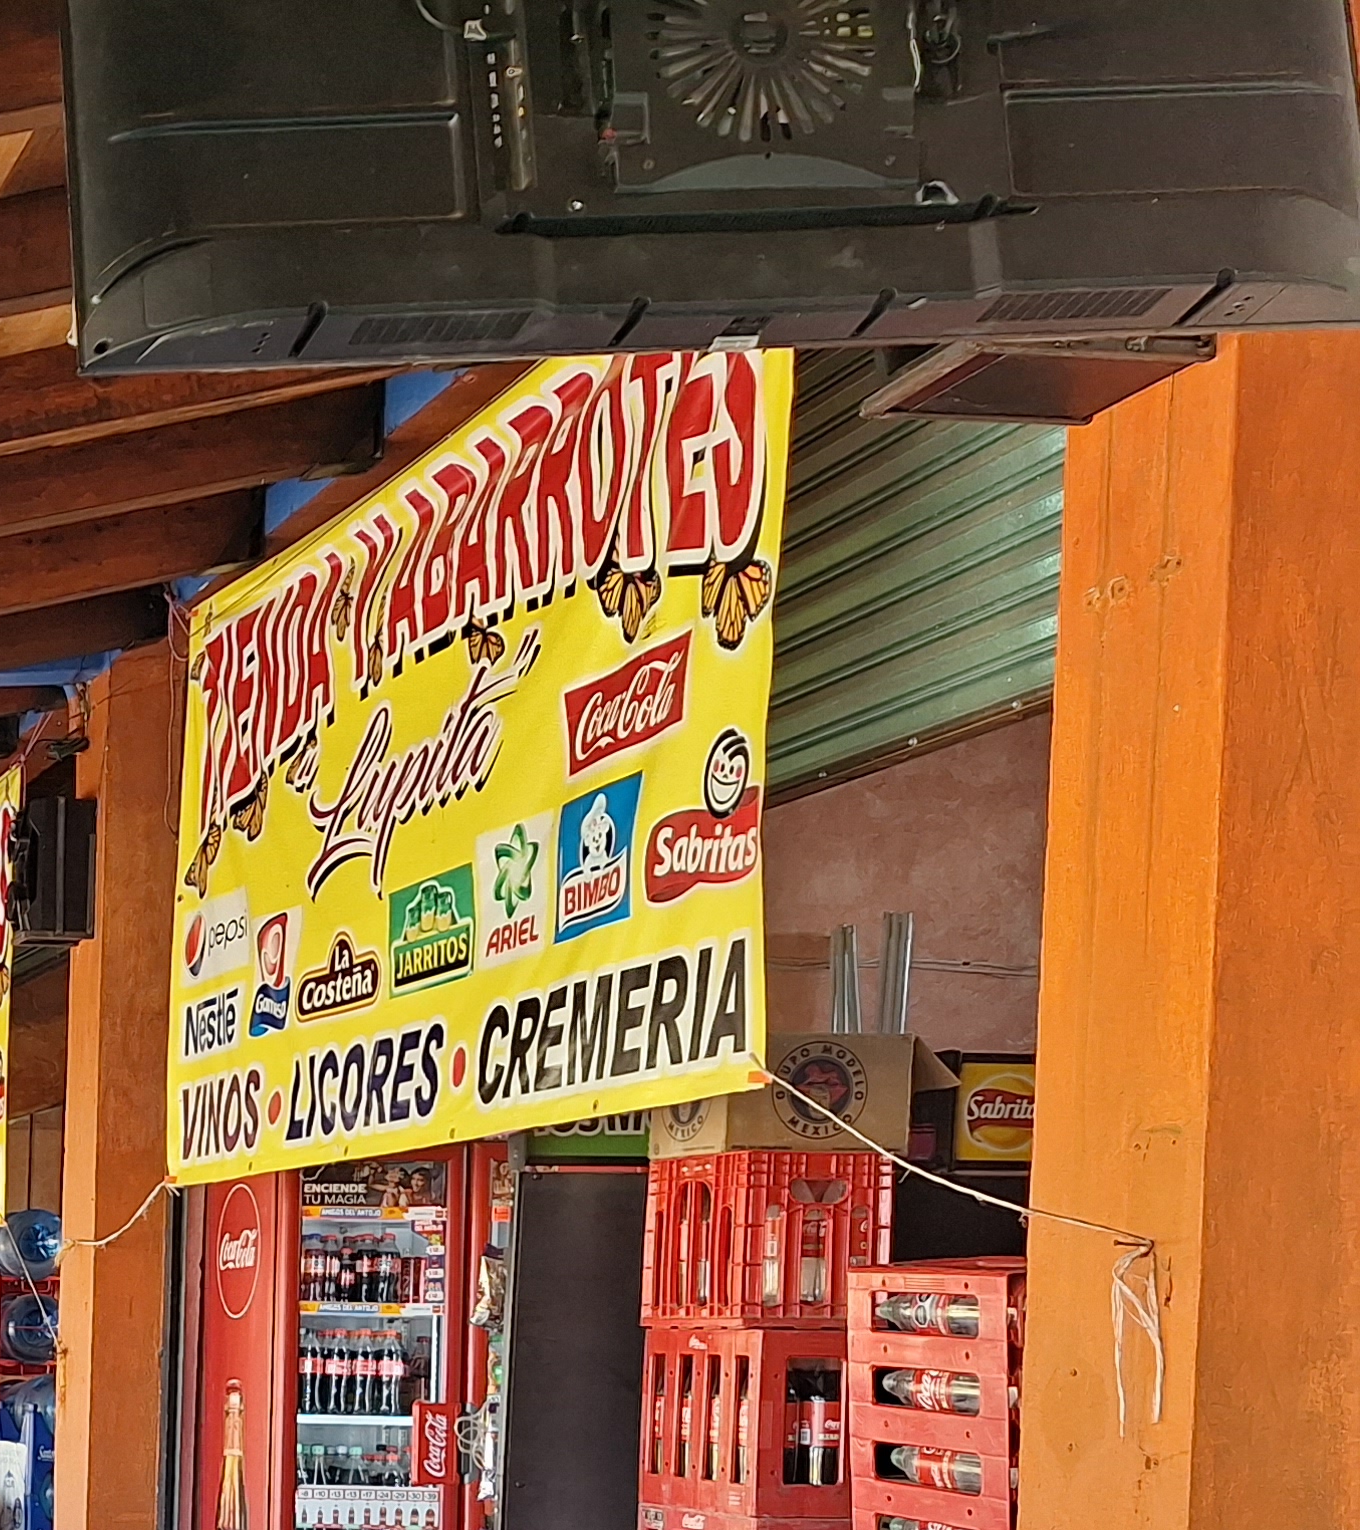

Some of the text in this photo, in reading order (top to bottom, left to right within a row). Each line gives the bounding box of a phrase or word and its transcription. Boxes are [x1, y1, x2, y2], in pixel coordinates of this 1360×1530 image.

[200, 351, 763, 834] TIENDA Y ABARROTES
[575, 650, 684, 761] Coca-Cola
[653, 822, 759, 878] Sabritas
[564, 864, 622, 917] BIMBO
[208, 909, 248, 956] pepsi
[396, 933, 468, 979] JARRITOS
[486, 915, 539, 958] ARIEL
[334, 946, 350, 972] La
[302, 967, 374, 1011] Costeña
[184, 987, 240, 1058] Nestlé
[181, 938, 748, 1161] VINOS LICORES CREMERIA
[822, 1044, 865, 1102] MODELO
[786, 1112, 854, 1138] MEXICO
[967, 1095, 1035, 1121] Sabrita
[303, 1183, 368, 1194] ENCIENDE
[304, 1194, 367, 1204] TU MAGIA
[423, 1410, 448, 1478] Coca-Cola
